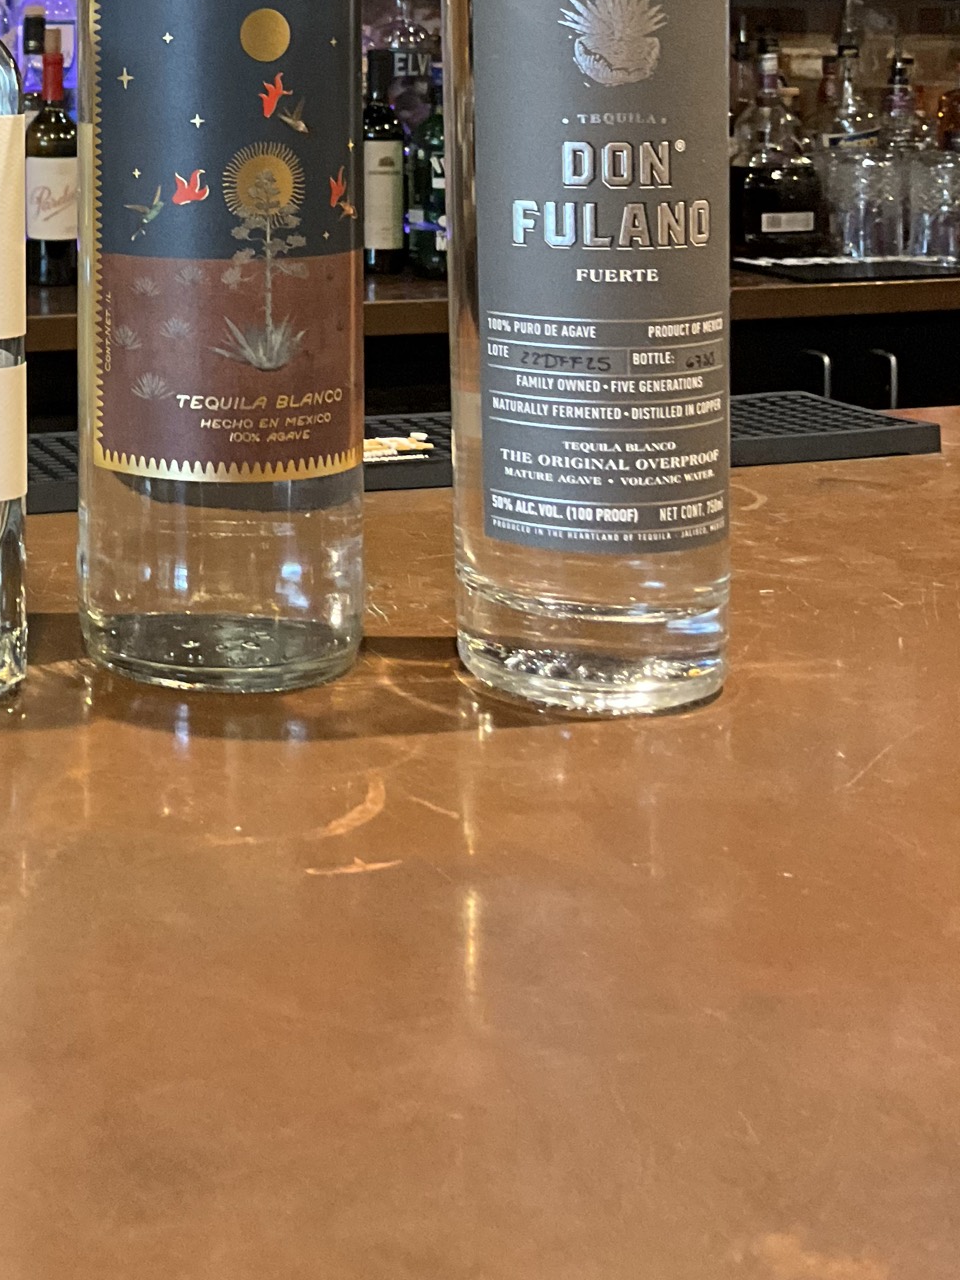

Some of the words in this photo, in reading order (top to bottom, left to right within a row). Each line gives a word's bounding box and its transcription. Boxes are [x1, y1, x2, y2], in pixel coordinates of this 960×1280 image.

[577, 113, 657, 125] TEQUILA
[561, 140, 673, 190] DON
[511, 199, 711, 251] FULANO
[576, 268, 659, 283] FUERTE
[487, 317, 512, 333] 100%
[514, 320, 541, 336] PURO
[544, 324, 558, 337] DE
[561, 325, 597, 338] AGAVE
[648, 323, 690, 338] PRODUCT
[691, 322, 701, 335] OF
[702, 318, 724, 333] MEXICO
[487, 343, 510, 358] LOTE
[632, 351, 676, 365] BOTTLE:
[516, 374, 554, 390] FAMILY
[557, 378, 601, 393] OWNED
[611, 380, 636, 393] FIVE
[639, 375, 704, 393] GENERATIONS
[176, 394, 268, 410] TEQUILA
[276, 387, 343, 410] BLANCO
[492, 396, 548, 416] NATURALLY
[552, 404, 622, 420] FERMENTED
[631, 405, 683, 420] DISTILLED
[685, 403, 695, 417] IN
[696, 398, 722, 415] COPPER
[200, 418, 254, 430] HECHO
[259, 418, 279, 429] EN
[285, 412, 331, 427] MEXICO
[229, 431, 260, 443] 100%
[266, 430, 310, 443] AGAVE
[562, 440, 623, 453] TEQUILA
[625, 441, 677, 452] BLANCO
[499, 447, 533, 464] THE
[538, 454, 630, 471] ORIGINAL
[635, 448, 720, 471] OVERPROOF
[504, 466, 554, 482] MATURE
[557, 474, 602, 486] AGAVE
[620, 474, 682, 486] VOLCANIC
[684, 468, 716, 482] WATER
[491, 494, 514, 512] 50%
[566, 505, 594, 521] (100
[596, 507, 638, 524] PROOF)
[659, 506, 678, 522] NET
[681, 502, 706, 520] CONT.
[492, 518, 531, 534] PRODUCED
[535, 527, 544, 536] IN
[547, 529, 564, 539] THE
[567, 531, 620, 542] HEARTLAND
[623, 533, 633, 542] OF
[638, 532, 672, 541] TEQUILA
